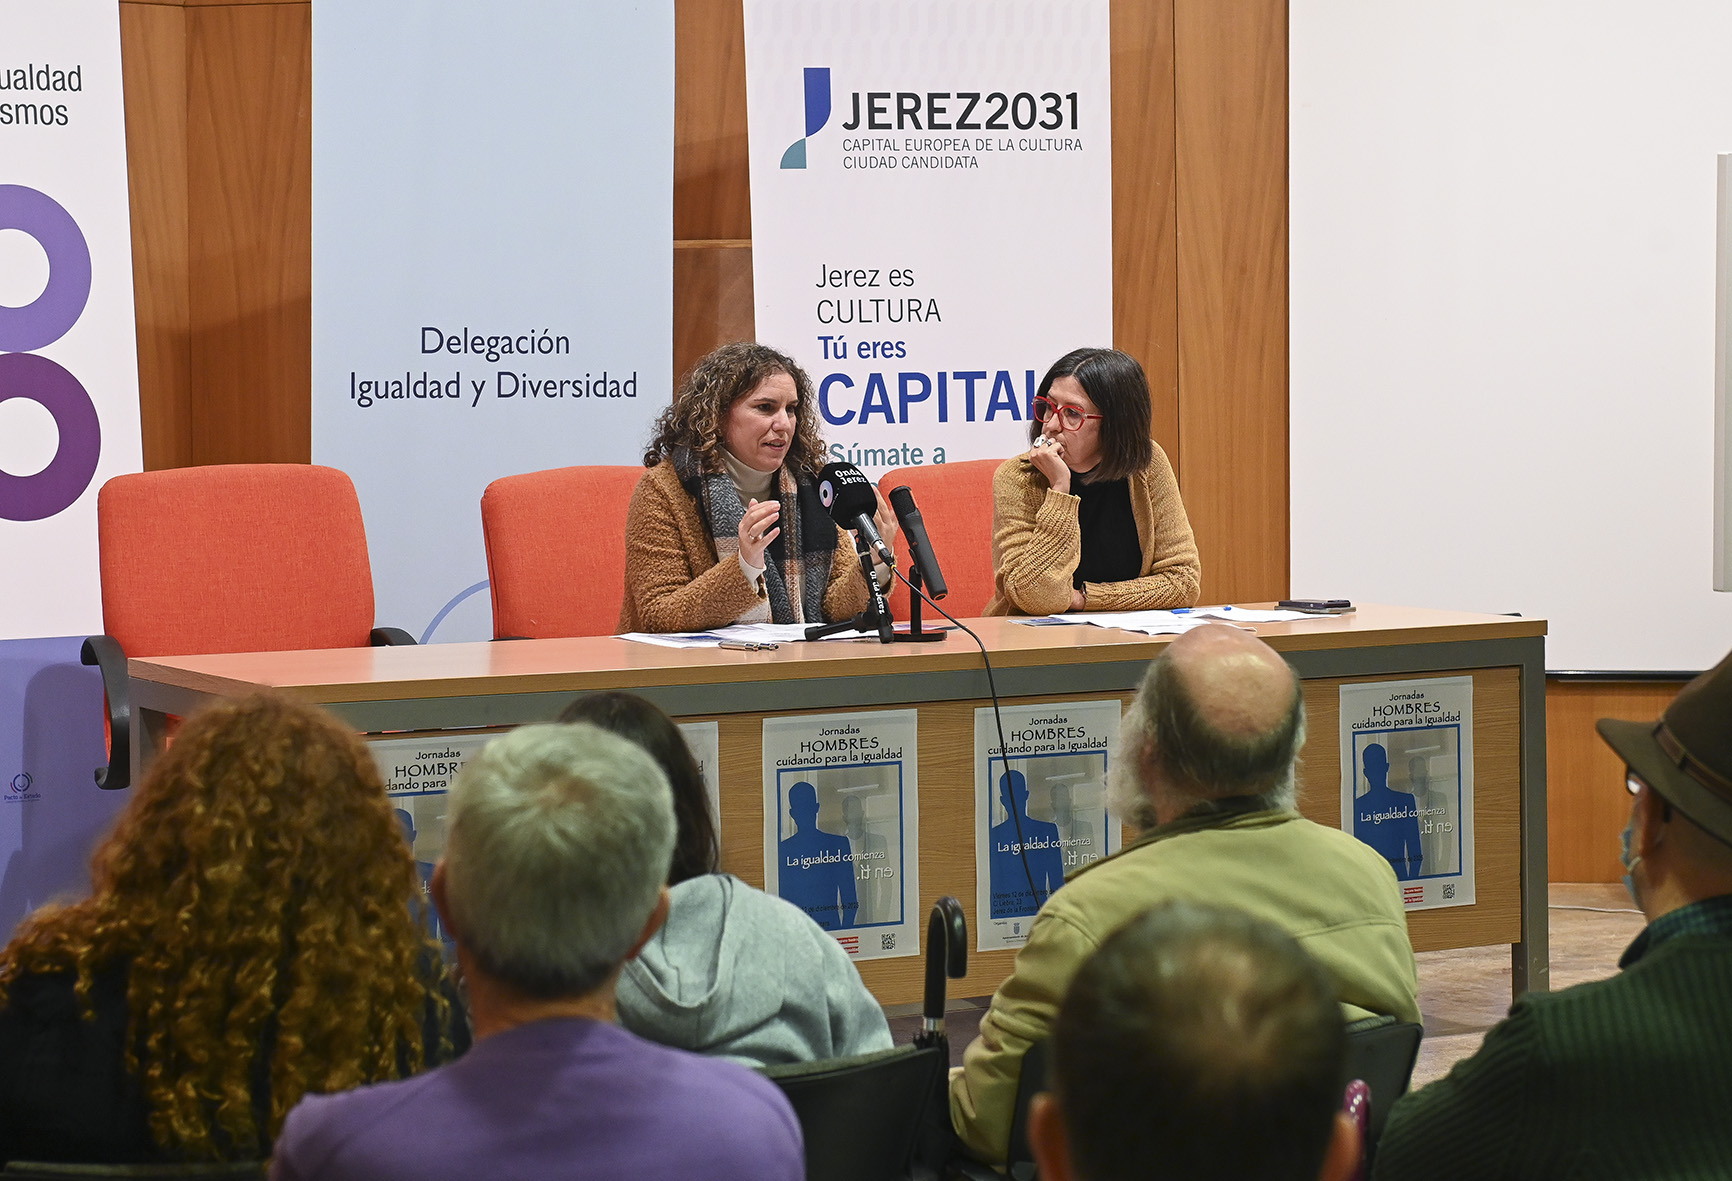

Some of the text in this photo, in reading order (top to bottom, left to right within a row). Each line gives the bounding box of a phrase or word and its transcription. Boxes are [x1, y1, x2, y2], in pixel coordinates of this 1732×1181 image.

[0, 103, 69, 125] smos
[842, 92, 1078, 130] JEREZ2031
[842, 138, 1083, 151] CAPITAL EUROPEA DE LA CULTURA
[843, 156, 979, 169] CIUDAD CANDIDATA
[816, 264, 915, 288] Jerez es
[817, 299, 942, 324] CULTURA
[421, 327, 570, 362] Delegación
[817, 335, 907, 360] Tú eres
[350, 371, 637, 408] Igualdad y Diversidad
[829, 442, 946, 467] Súmate a
[834, 468, 862, 478] Onda
[840, 476, 867, 485] Jerez
[1389, 690, 1425, 701] Jornadas
[1373, 701, 1441, 717] HOMBRES
[1029, 714, 1068, 726] Jornadas
[1352, 710, 1461, 729] cuidando para la Igualdad
[819, 724, 860, 736] Jornadas
[1011, 726, 1086, 742] HOMBRES
[801, 737, 879, 752] HOMBRES
[1034, 744, 1055, 755] para
[1058, 739, 1065, 750] la
[1069, 736, 1107, 753] Igualdad
[415, 747, 461, 760] Jornadas
[776, 747, 902, 766] cuidando para la Igualdad
[395, 762, 466, 778] HOMBR
[384, 777, 447, 792] dando para
[1361, 806, 1446, 824] La igualdad comienza
[997, 842, 1009, 852] La
[1051, 836, 1091, 848] comienza
[787, 849, 885, 869] La igualdad comienza
